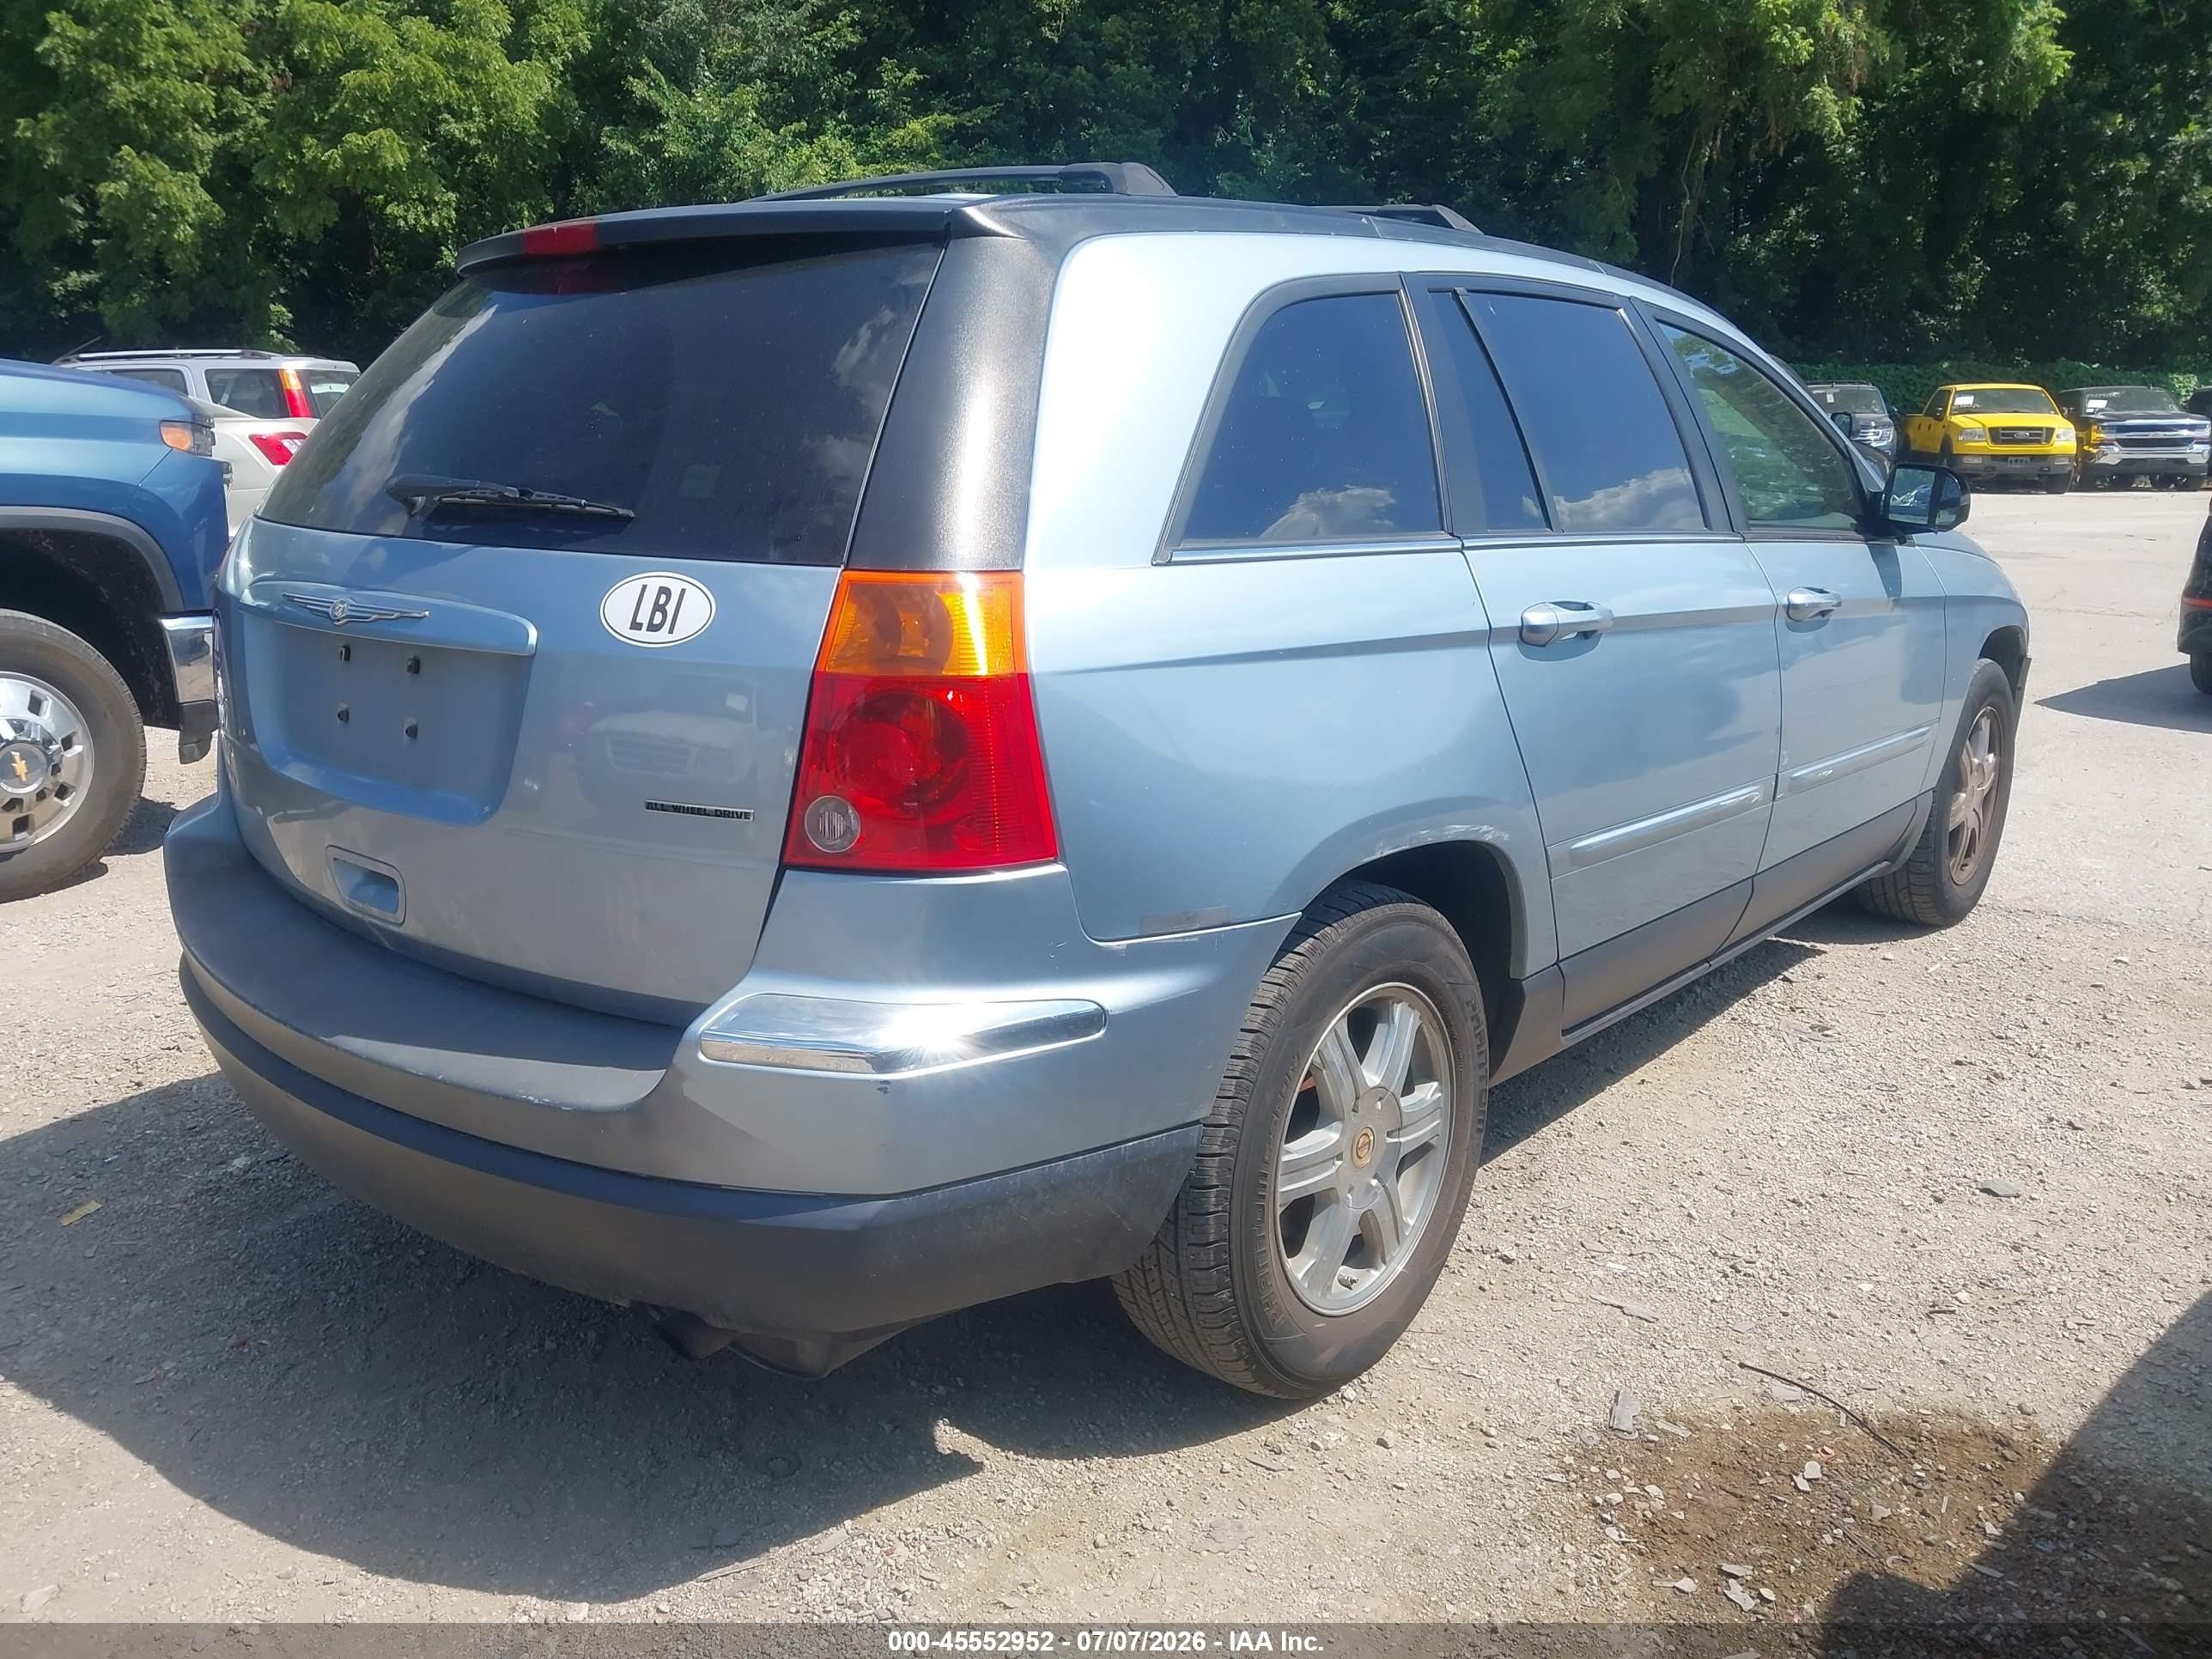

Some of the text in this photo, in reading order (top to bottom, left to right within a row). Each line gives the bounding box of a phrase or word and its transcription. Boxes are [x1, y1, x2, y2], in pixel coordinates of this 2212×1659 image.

[629, 584, 686, 634] LBI
[646, 802, 751, 820] ALL WHEEL DRIVE
